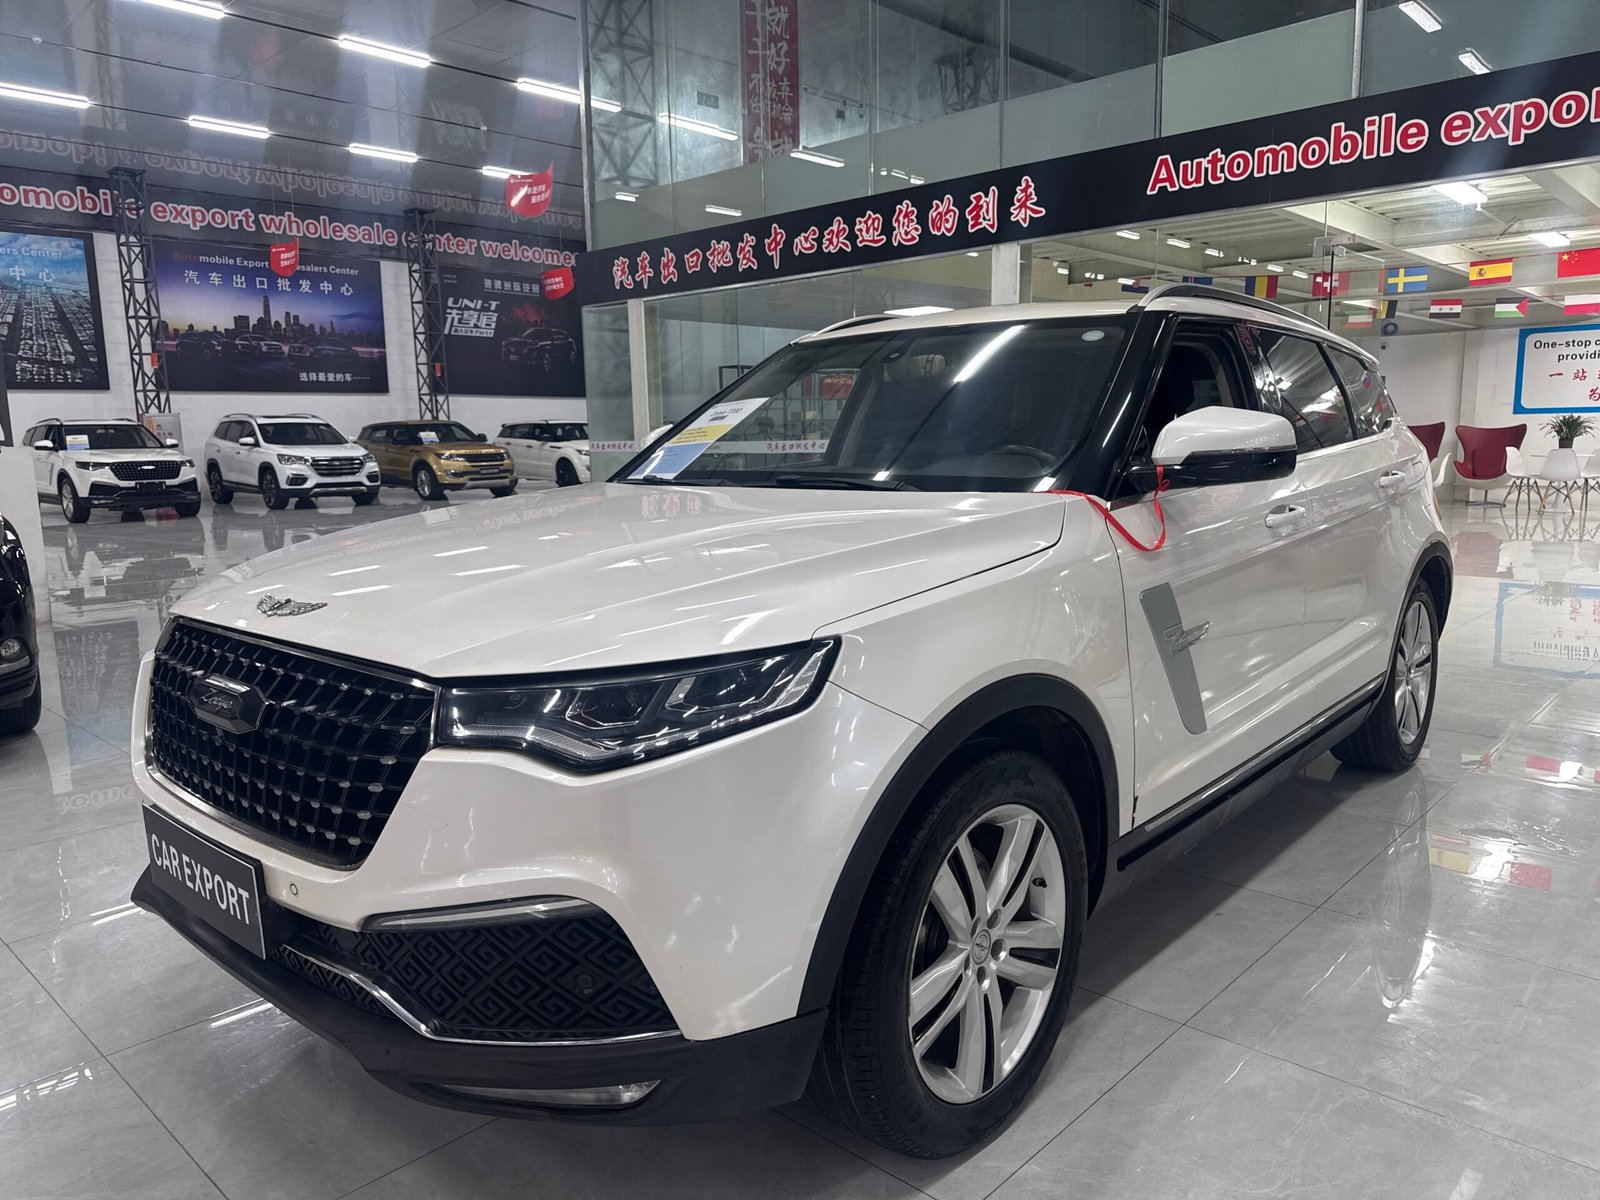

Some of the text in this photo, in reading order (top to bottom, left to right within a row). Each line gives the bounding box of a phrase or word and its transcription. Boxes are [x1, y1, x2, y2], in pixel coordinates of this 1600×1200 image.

[1146, 112, 1429, 195] Automobile
[150, 201, 255, 231] export
[260, 212, 398, 247] wholesale
[480, 240, 578, 266] welcome
[612, 174, 1047, 291] 汽车出口批发中心欢迎您的到来
[21, 246, 63, 258] Center
[9, 265, 57, 282] 中心
[236, 257, 269, 270] Export
[329, 266, 359, 276] Center
[184, 269, 354, 296] 汽车出口批发中心
[447, 297, 500, 310] UNI-T
[1534, 339, 1591, 349] One-stop
[151, 833, 249, 925] CAR EXPORT
